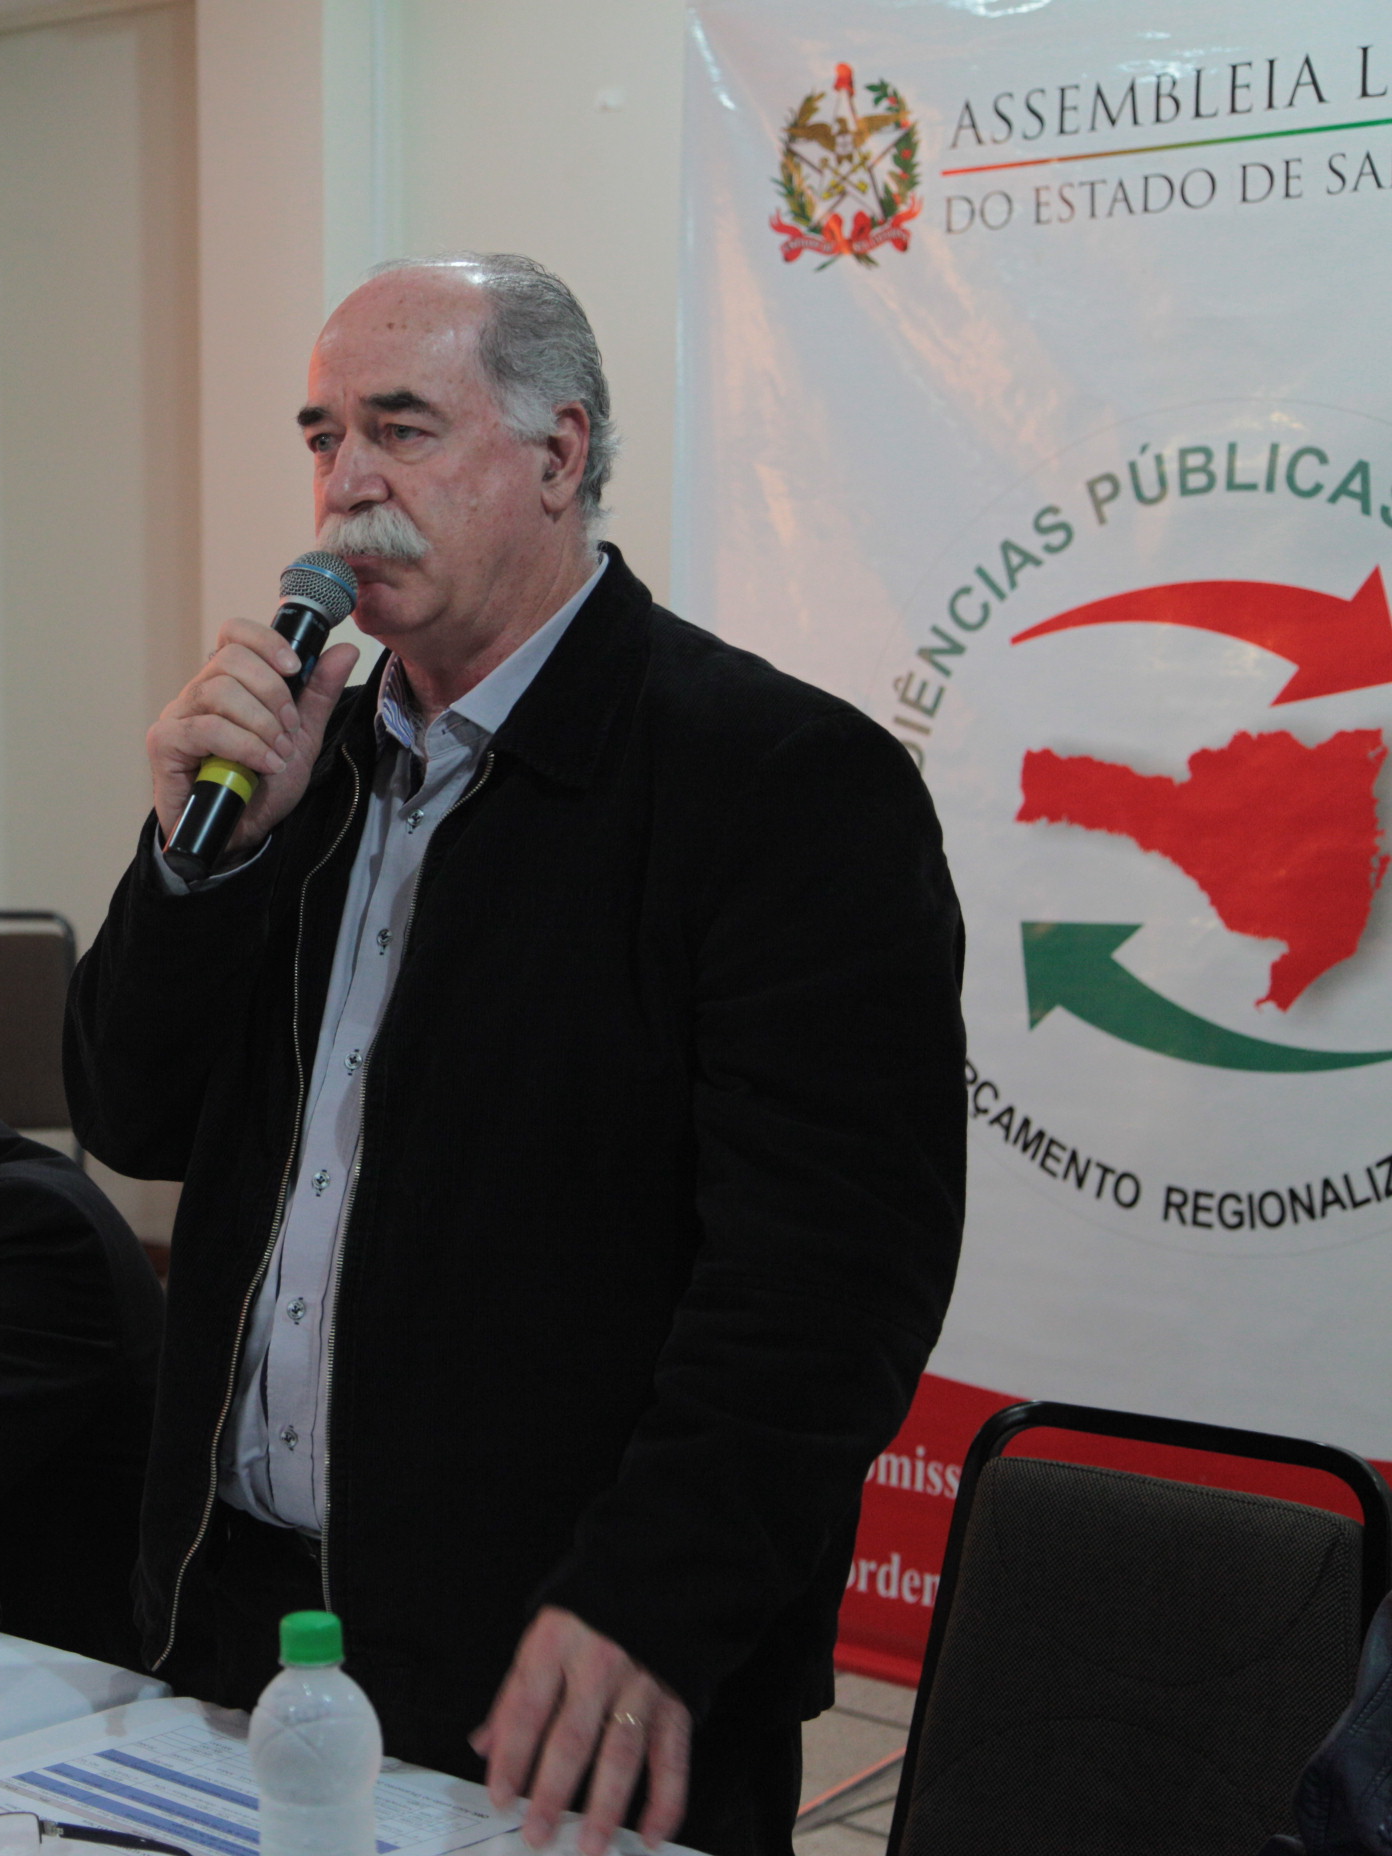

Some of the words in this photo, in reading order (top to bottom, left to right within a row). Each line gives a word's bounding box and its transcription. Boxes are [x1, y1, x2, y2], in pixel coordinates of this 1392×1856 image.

[949, 52, 1330, 150] ASSEMBLEIA
[1357, 44, 1388, 99] L
[944, 189, 1014, 236] DO
[1032, 168, 1218, 226] ESTADO
[1239, 157, 1304, 204] DE
[1325, 149, 1392, 196] SA
[865, 1445, 962, 1500] miss
